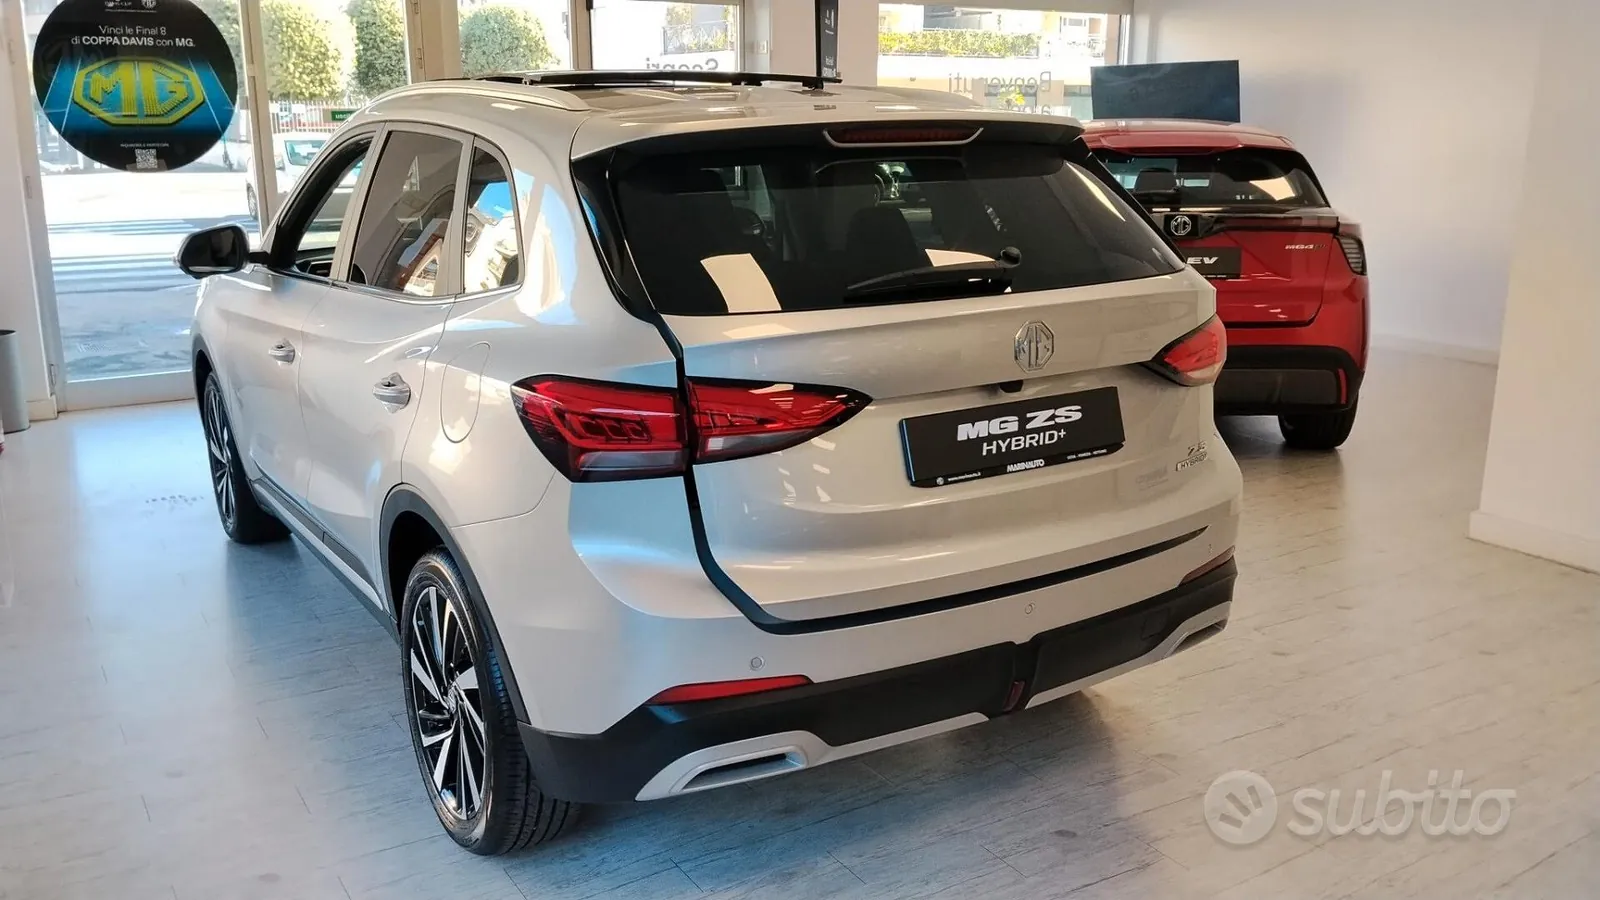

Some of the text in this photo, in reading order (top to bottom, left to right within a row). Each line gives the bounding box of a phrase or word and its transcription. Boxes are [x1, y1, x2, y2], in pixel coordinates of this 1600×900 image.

[98, 25, 167, 36] Vinci le Final 8
[71, 36, 80, 45] di
[82, 36, 120, 46] COPPA
[121, 37, 154, 46] DAVIS
[156, 39, 174, 47] con
[84, 60, 191, 118] MG
[1171, 215, 1191, 235] MG
[1186, 256, 1219, 265] EV
[1015, 322, 1053, 371] MG
[957, 405, 1083, 442] MG ZS
[982, 428, 1067, 456] HYBRID+
[1006, 458, 1046, 473] MARINAUTO
